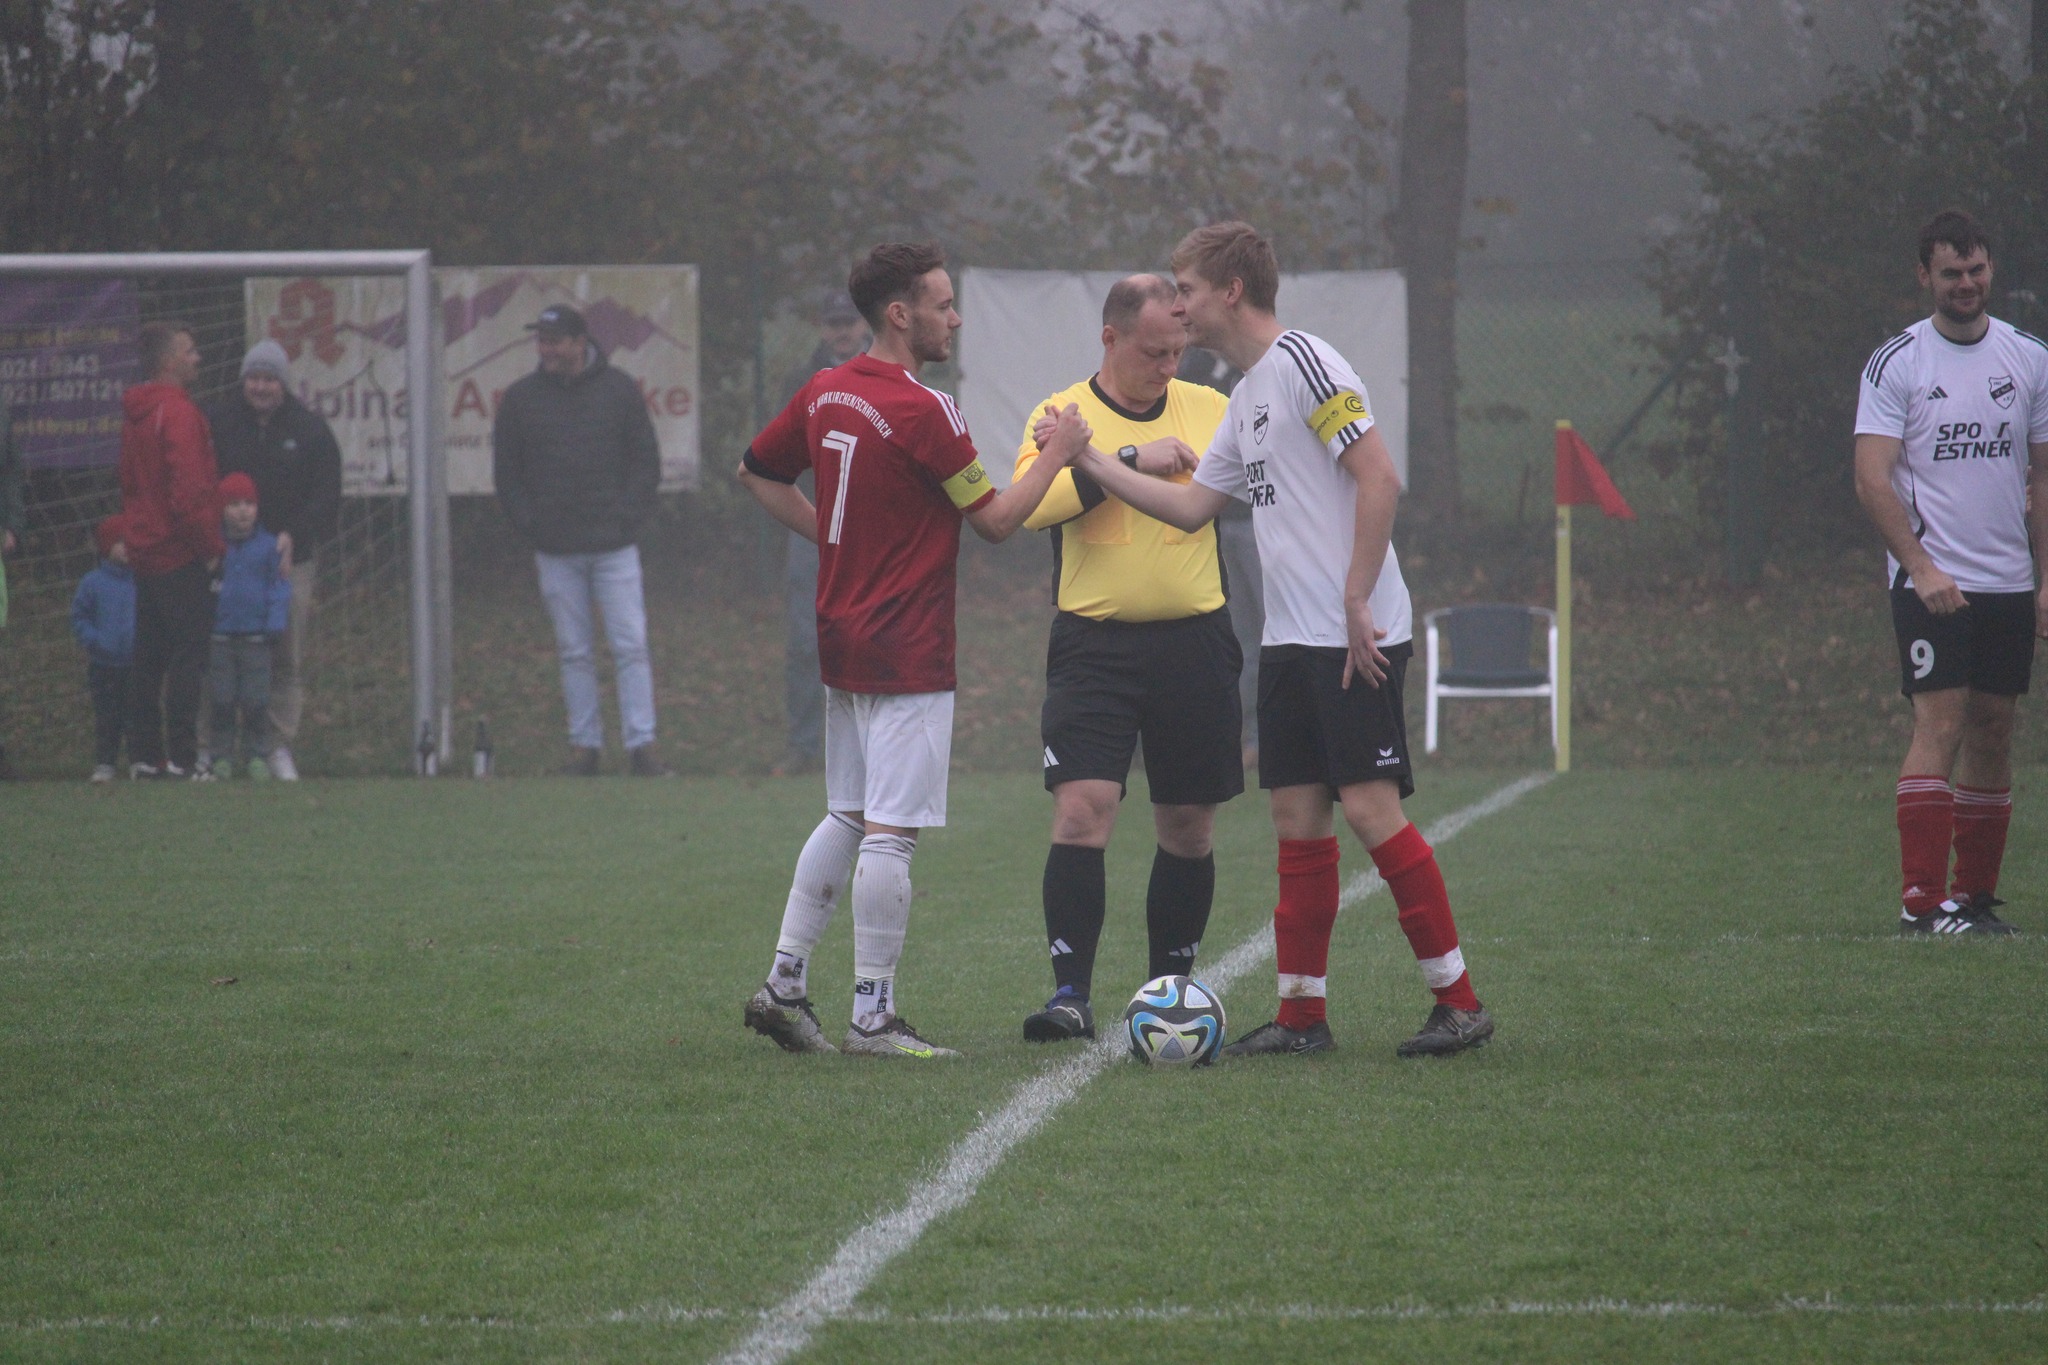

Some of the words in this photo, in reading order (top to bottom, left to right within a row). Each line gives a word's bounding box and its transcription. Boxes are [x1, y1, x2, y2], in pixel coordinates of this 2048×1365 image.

[1345, 396, 1365, 413] C
[1933, 441, 2011, 461] ESTNER
[822, 430, 858, 545] 7
[1910, 638, 1935, 680] 9
[1376, 757, 1400, 767] erima
